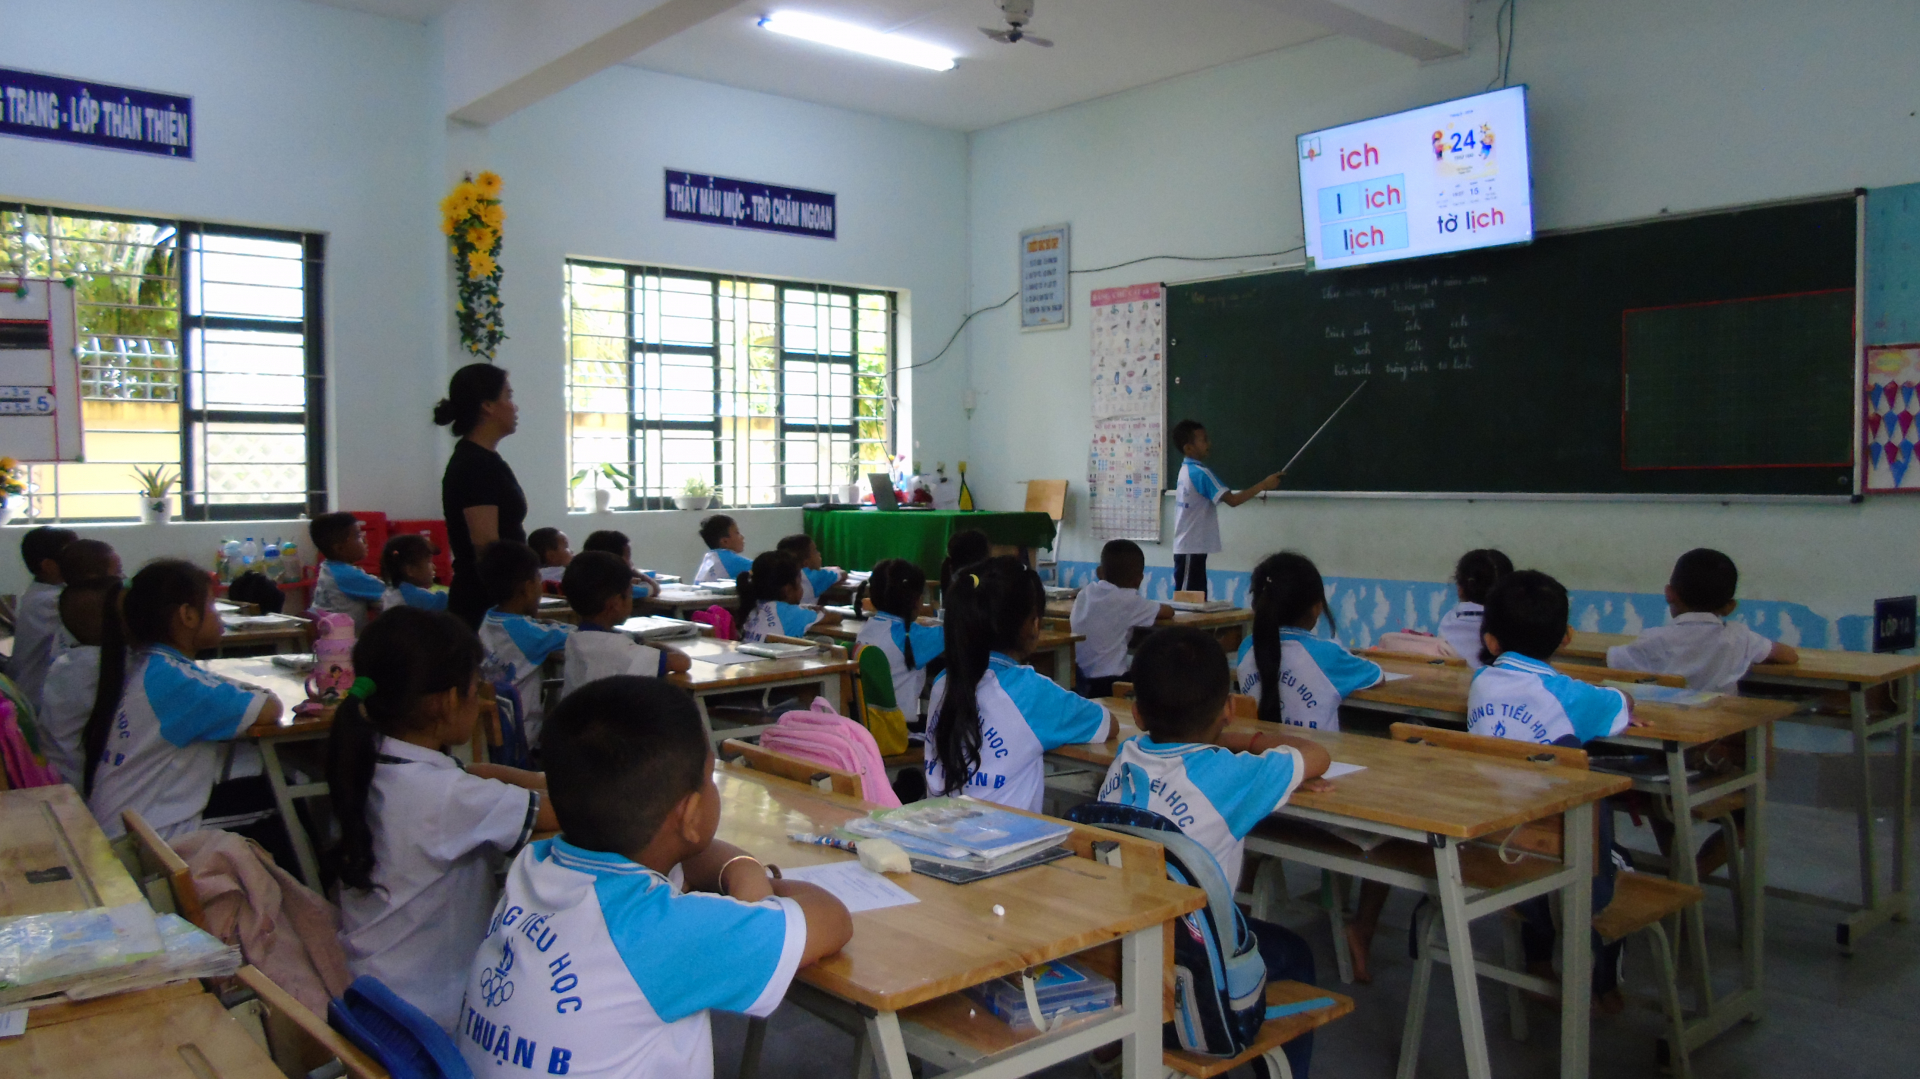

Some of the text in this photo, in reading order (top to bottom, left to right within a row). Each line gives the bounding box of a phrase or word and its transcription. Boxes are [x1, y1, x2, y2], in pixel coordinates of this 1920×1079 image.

[7, 87, 59, 129] TRANG
[70, 88, 99, 133] LỚP
[145, 103, 188, 155] THIỆN
[1451, 129, 1476, 153] 24
[1340, 143, 1379, 171] ich
[752, 190, 771, 223] TRÒ
[801, 202, 832, 231] NGOAN
[1365, 184, 1401, 209] ich
[1437, 207, 1504, 234] tờ lịch
[1343, 225, 1384, 254] lịch
[37, 395, 50, 412] 5
[1297, 684, 1317, 709] HỌC
[1501, 703, 1533, 724] TIỂU
[984, 726, 1009, 759] HỌC
[993, 774, 1006, 789] B
[1165, 790, 1194, 828] HỌC
[548, 952, 583, 1014] HỌC
[465, 1006, 572, 1076] THUẬN B
